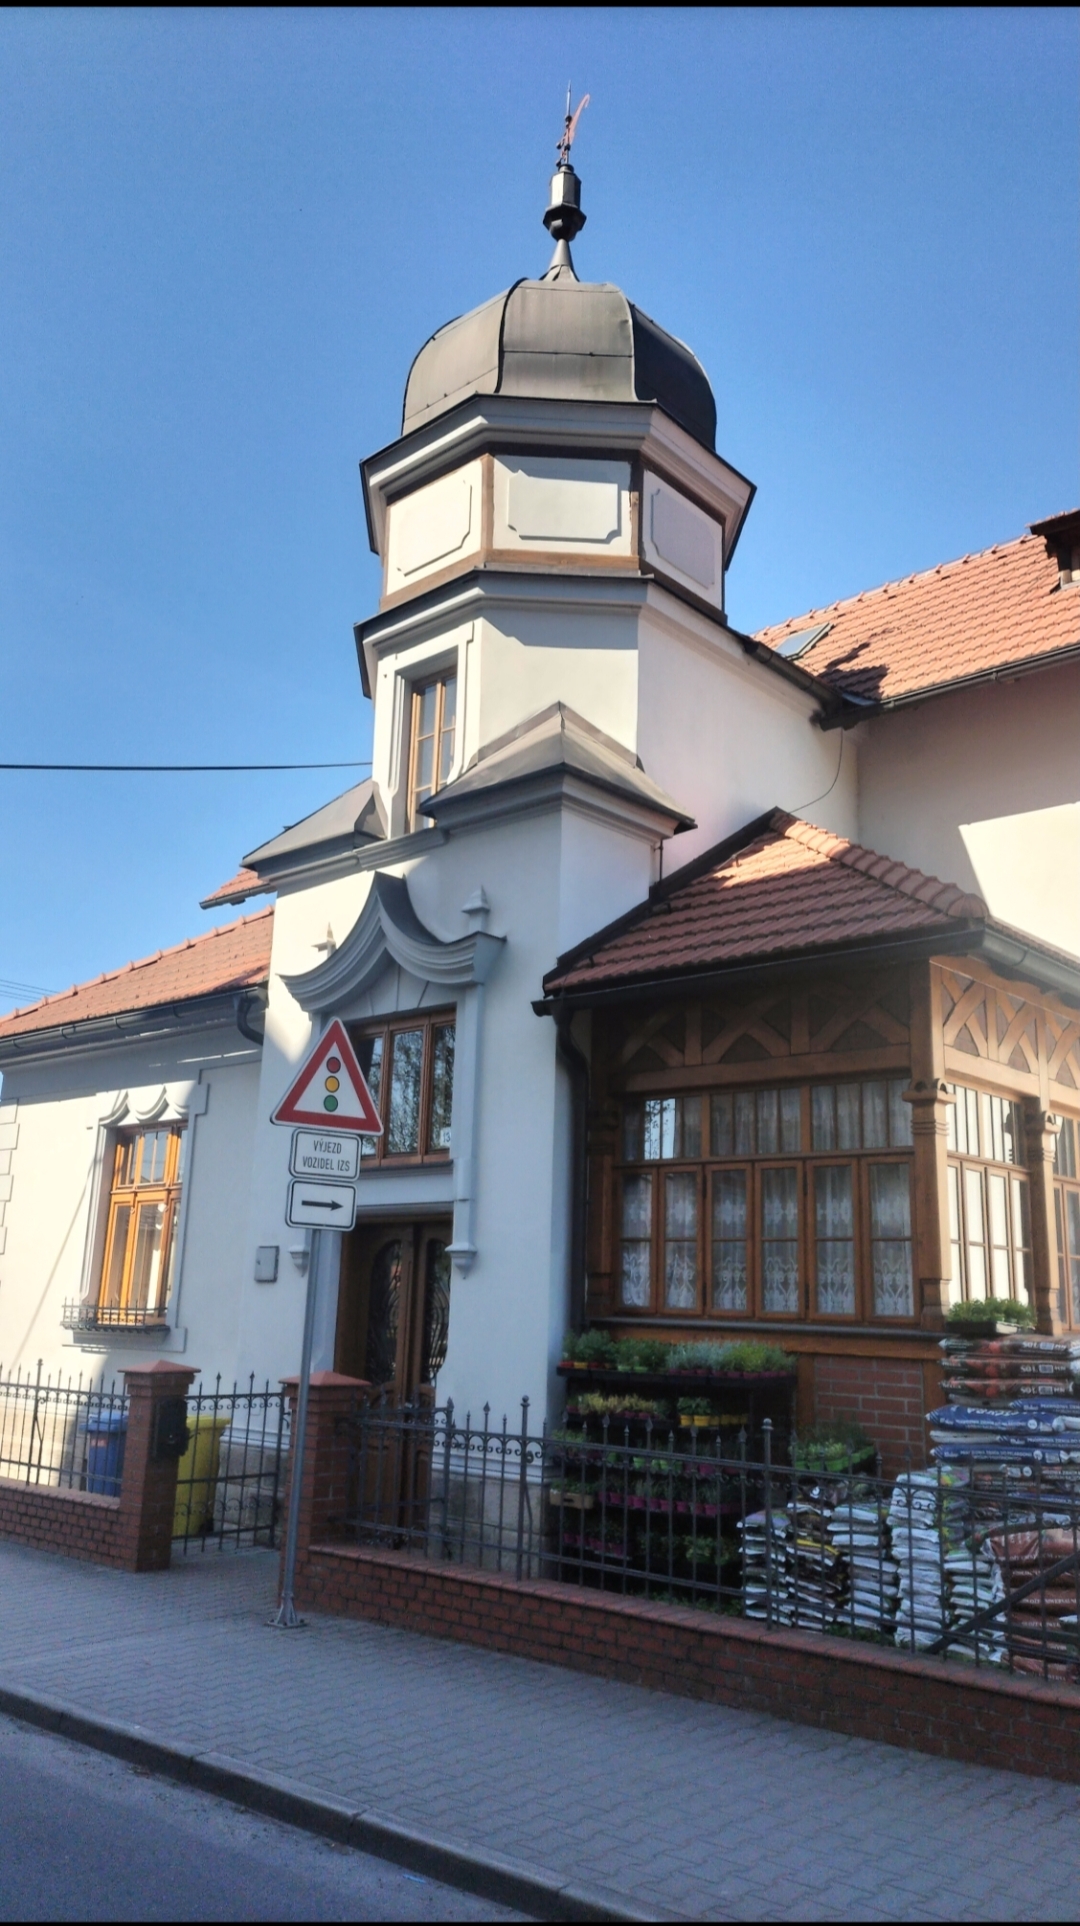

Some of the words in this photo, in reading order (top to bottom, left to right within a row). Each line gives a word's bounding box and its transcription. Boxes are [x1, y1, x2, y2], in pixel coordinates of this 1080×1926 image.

[313, 1138, 342, 1154] VÝJEZD
[302, 1156, 335, 1171] VOZIDEL
[337, 1159, 351, 1172] IZS
